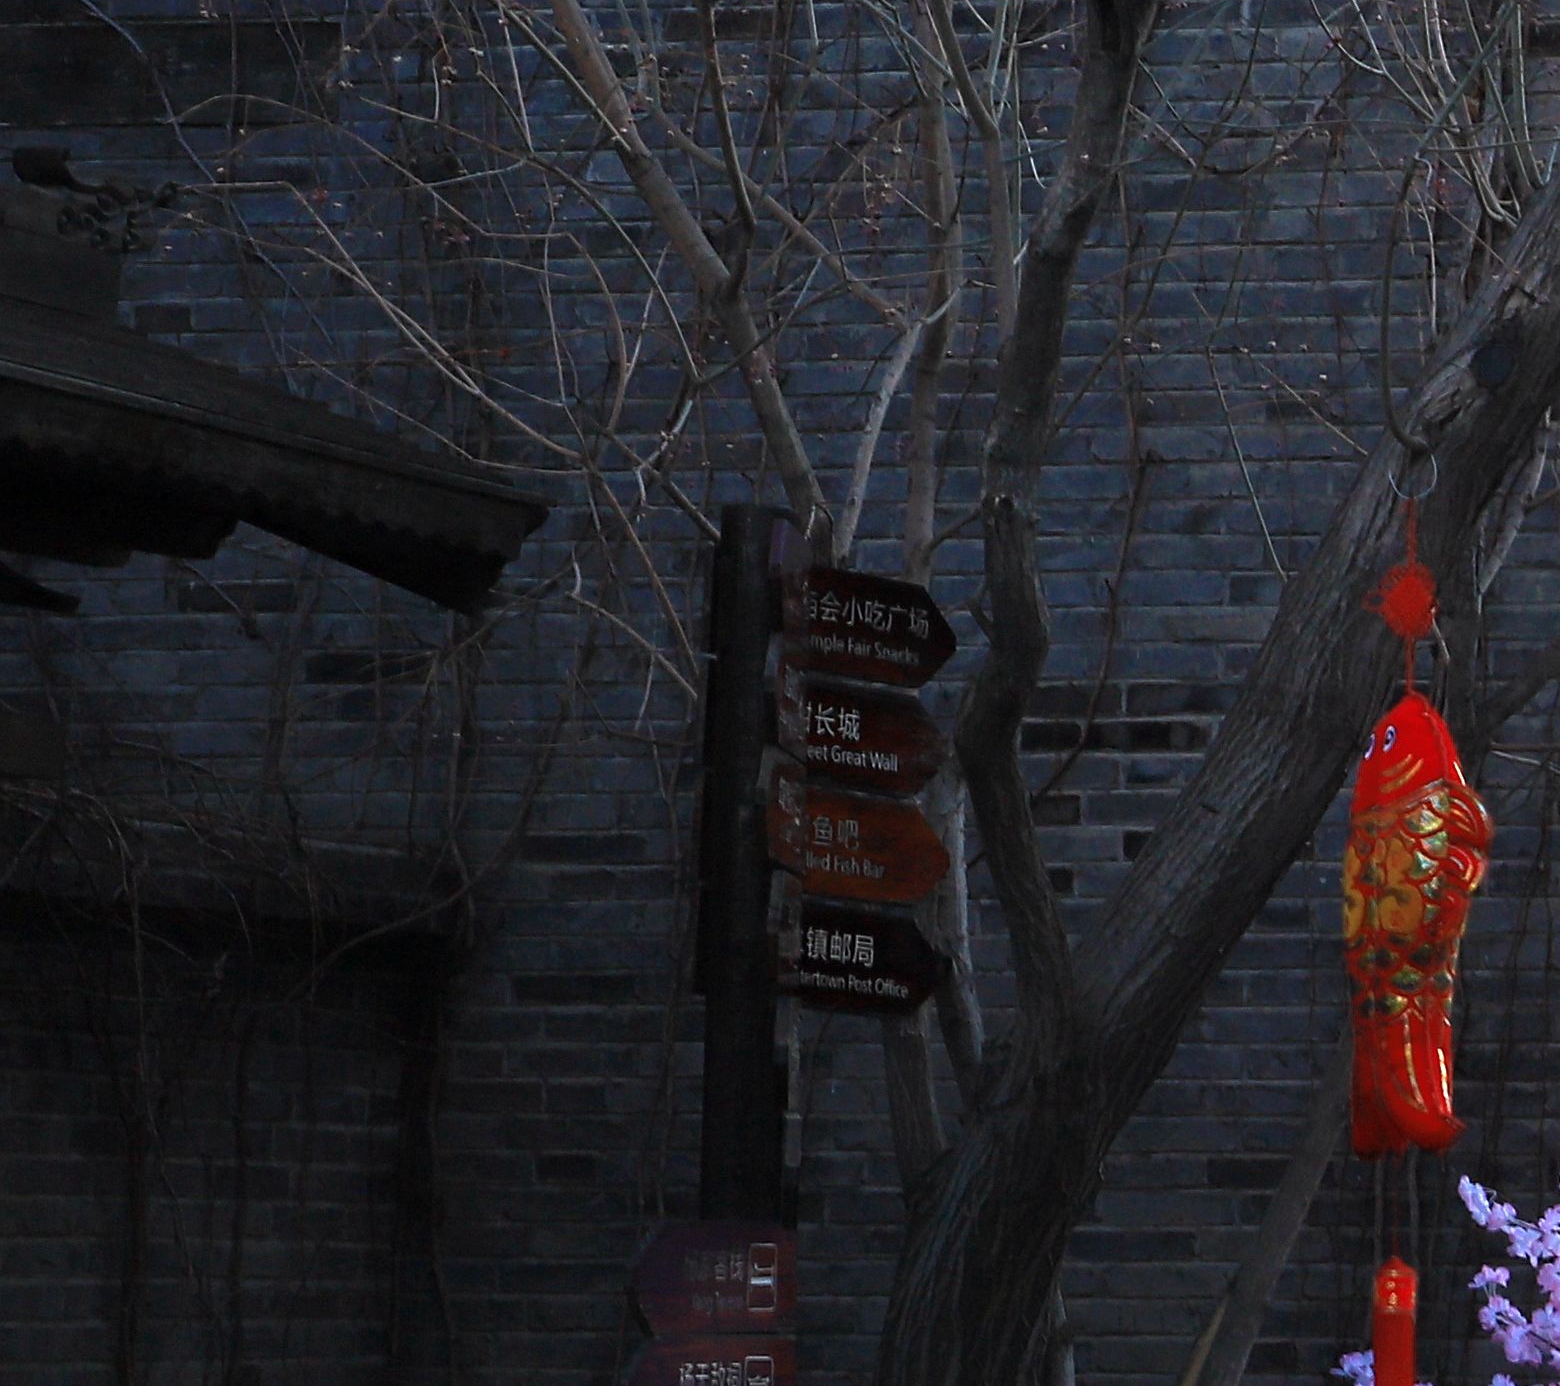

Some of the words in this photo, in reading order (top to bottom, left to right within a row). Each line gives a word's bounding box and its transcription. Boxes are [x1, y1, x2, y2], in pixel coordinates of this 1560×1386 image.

[810, 633, 845, 655] mple
[848, 636, 872, 657] Fair
[807, 745, 828, 762] eet
[831, 745, 867, 769] Great
[870, 751, 898, 773] Wall
[809, 815, 860, 849] 鱼吧
[834, 854, 860, 877] Fish
[863, 858, 885, 879] Bar
[801, 925, 875, 968] 镇邮局
[800, 969, 846, 990] tertown
[848, 973, 873, 994] Post
[875, 977, 910, 999] Office
